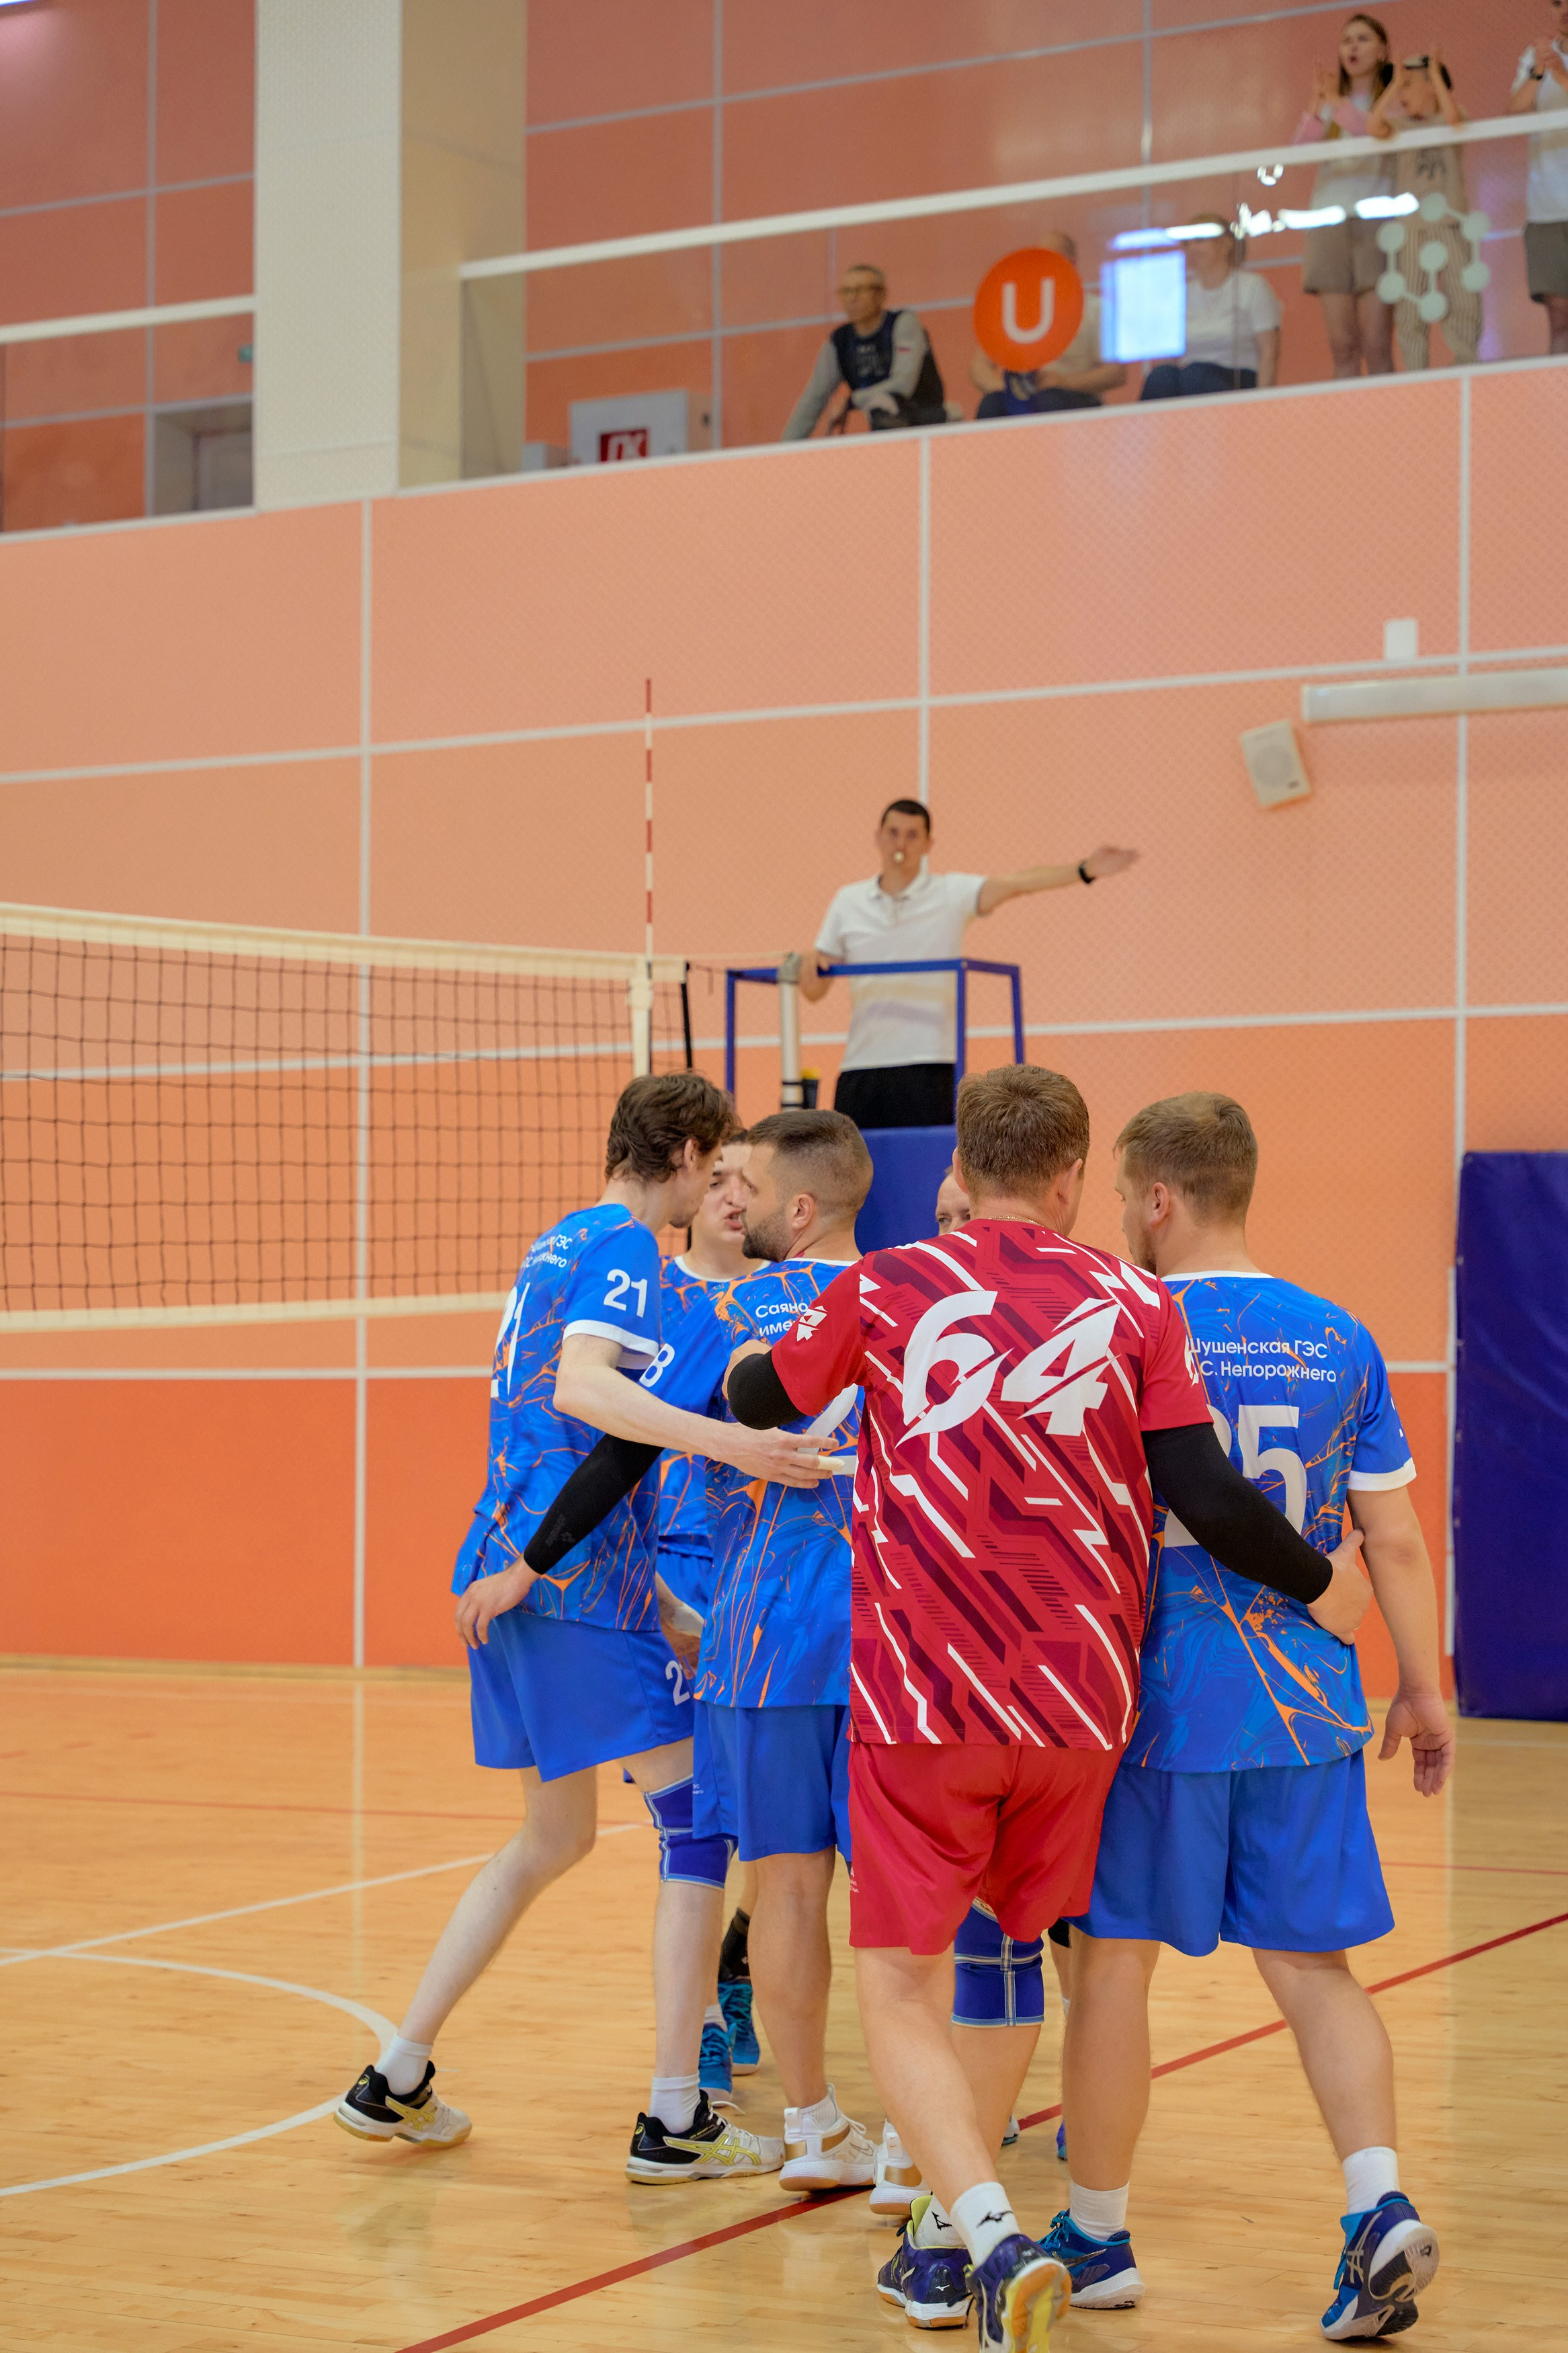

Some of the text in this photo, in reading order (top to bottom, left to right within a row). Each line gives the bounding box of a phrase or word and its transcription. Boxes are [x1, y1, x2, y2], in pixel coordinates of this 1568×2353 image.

[604, 1269, 648, 1318] 21
[755, 1302, 809, 1318] Саяно
[759, 1320, 796, 1337] име
[1294, 1339, 1329, 1359] ГЭС
[895, 1290, 1121, 1450] 64
